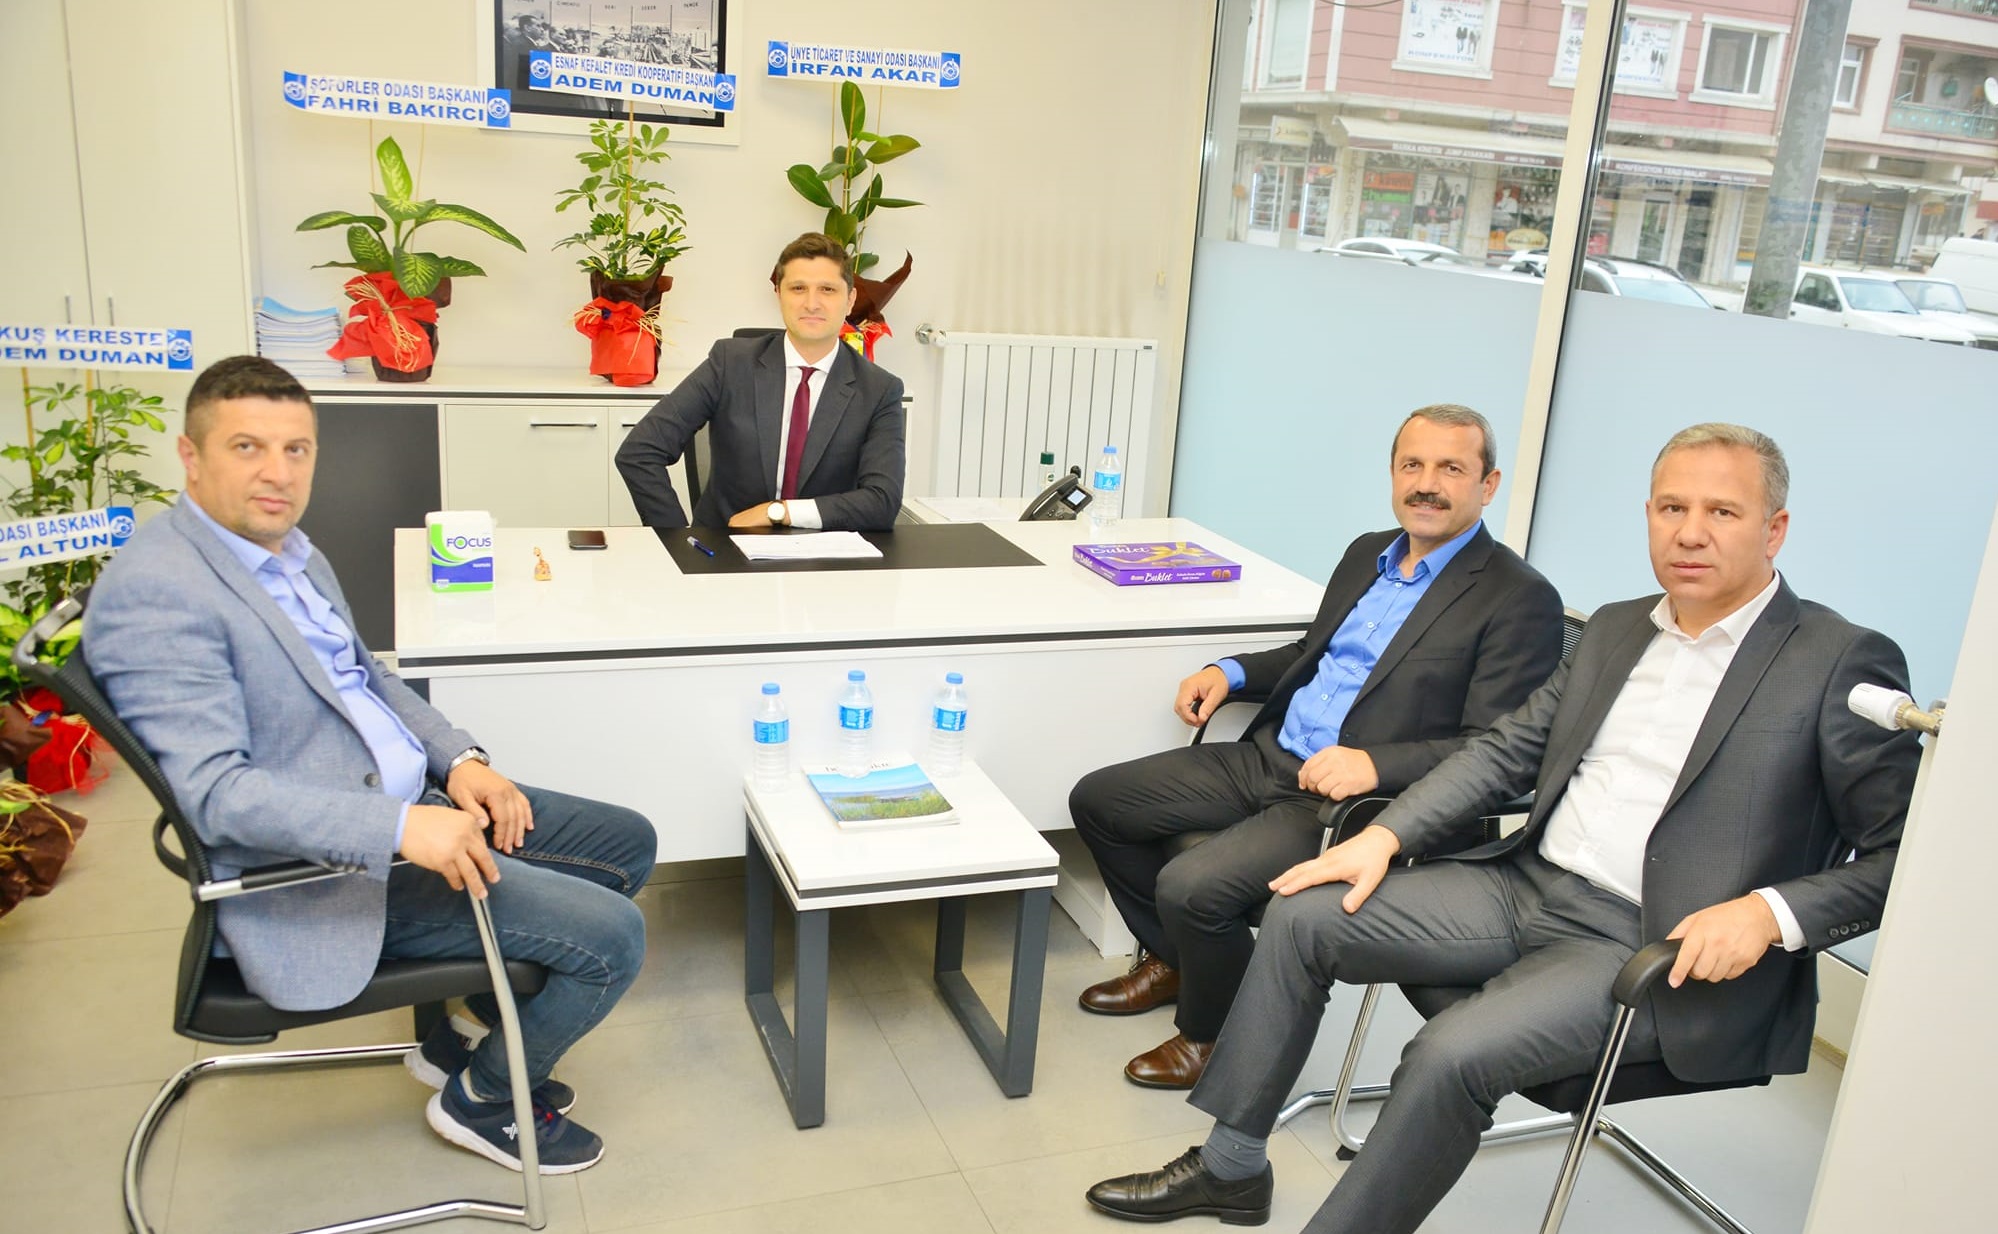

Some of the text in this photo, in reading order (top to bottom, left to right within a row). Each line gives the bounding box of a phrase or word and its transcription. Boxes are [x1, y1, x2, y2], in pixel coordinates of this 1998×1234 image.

[555, 55, 579, 70] ESNAF
[581, 60, 612, 75] KEFALET
[614, 64, 636, 80] KREDİ
[790, 45, 940, 72] ÜNYE TİCARET VE SANAYİ ODASI BAŞKANI
[791, 60, 937, 83] İRFAN AKAR
[383, 83, 424, 100] ODASI
[427, 85, 486, 105] BAŞKANI
[555, 74, 714, 105] ADEM DUMAN
[308, 95, 484, 122] FAHRİ BAKIRCI
[56, 329, 162, 346] KERESTE
[0, 347, 163, 364] EM DUMAN
[37, 512, 106, 538] BAŞKANI
[19, 533, 108, 559] ALTUN
[446, 536, 492, 549] FOCUS
[1144, 572, 1174, 583] Buklet
